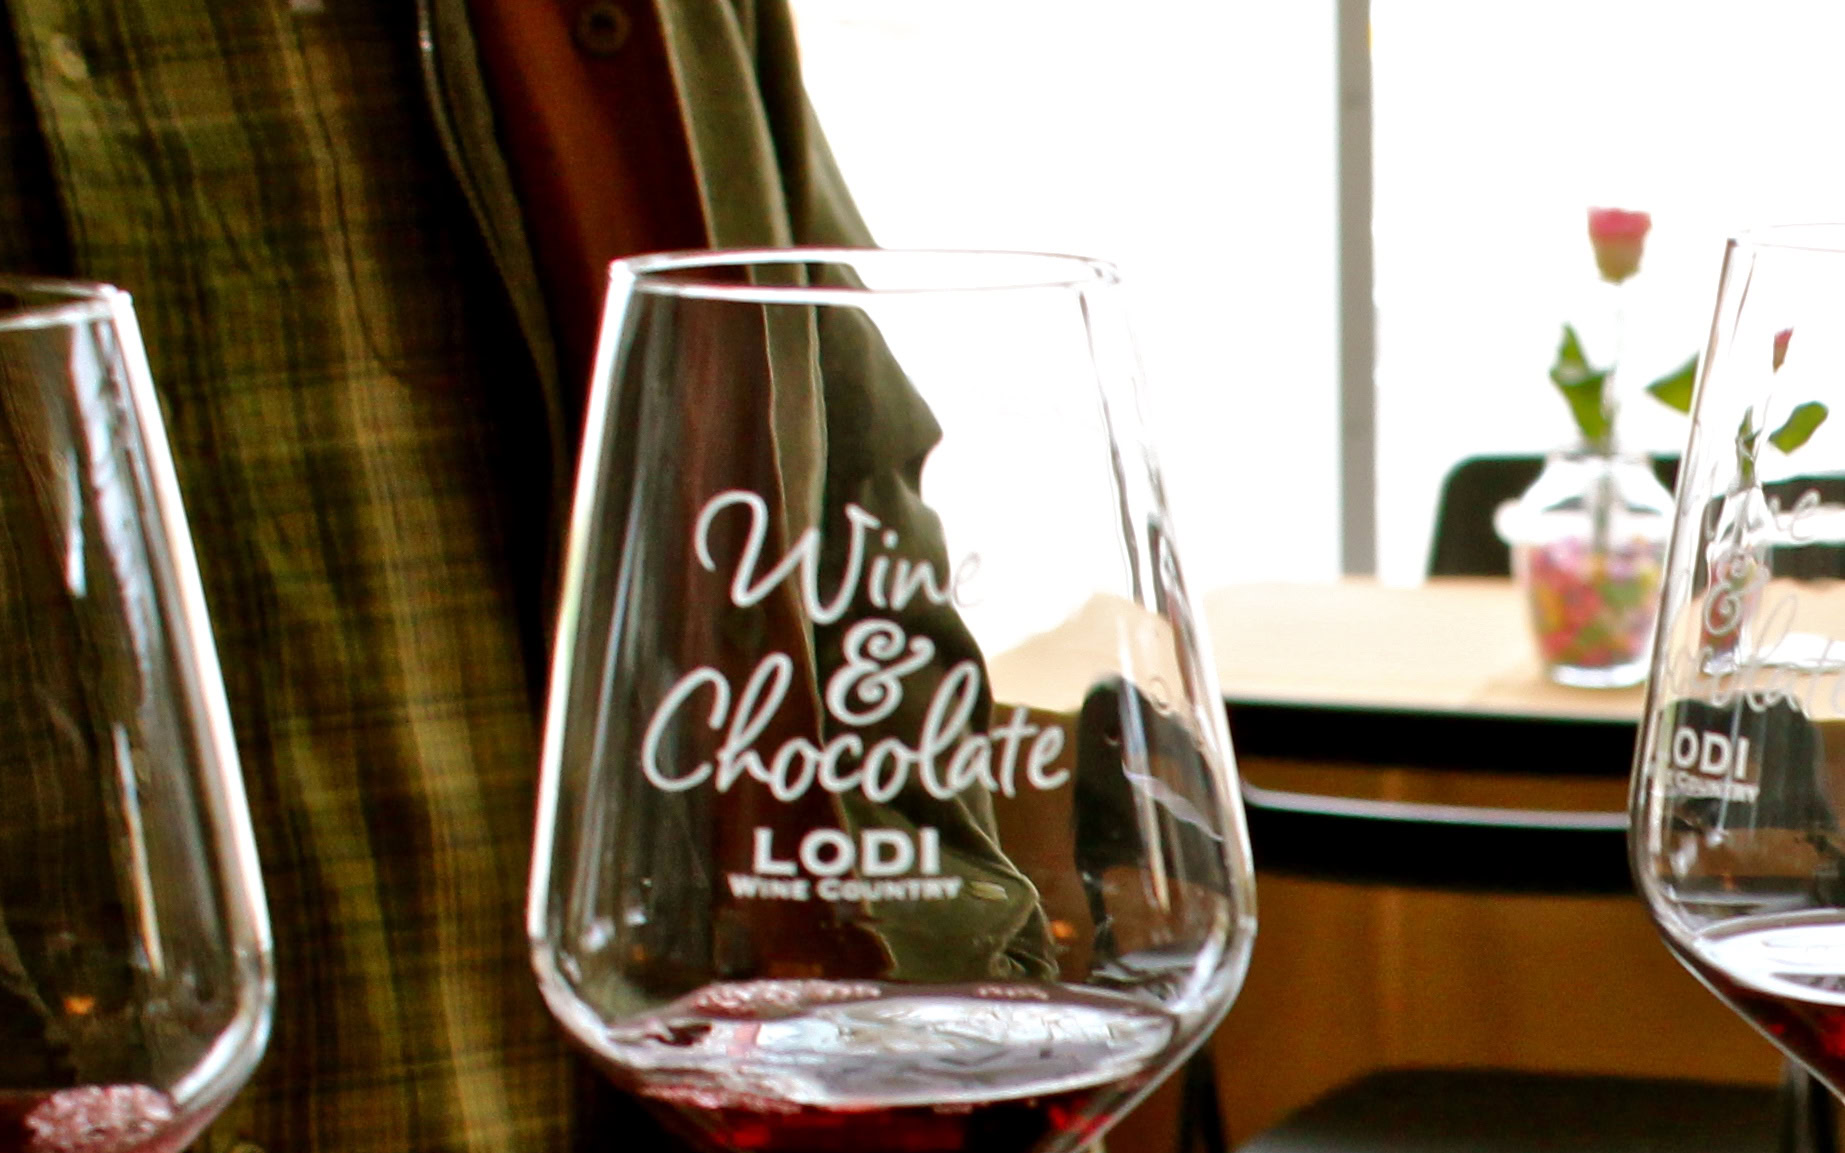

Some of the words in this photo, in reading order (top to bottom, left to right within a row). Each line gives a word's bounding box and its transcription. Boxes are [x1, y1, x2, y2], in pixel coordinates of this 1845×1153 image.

[695, 490, 984, 625] Wine
[826, 617, 935, 728] &
[642, 651, 1070, 803] Chocolate
[1672, 726, 1751, 780] ODI
[727, 873, 811, 900] WINE
[816, 876, 963, 902] COUNTRY
[753, 826, 941, 876] LODI
